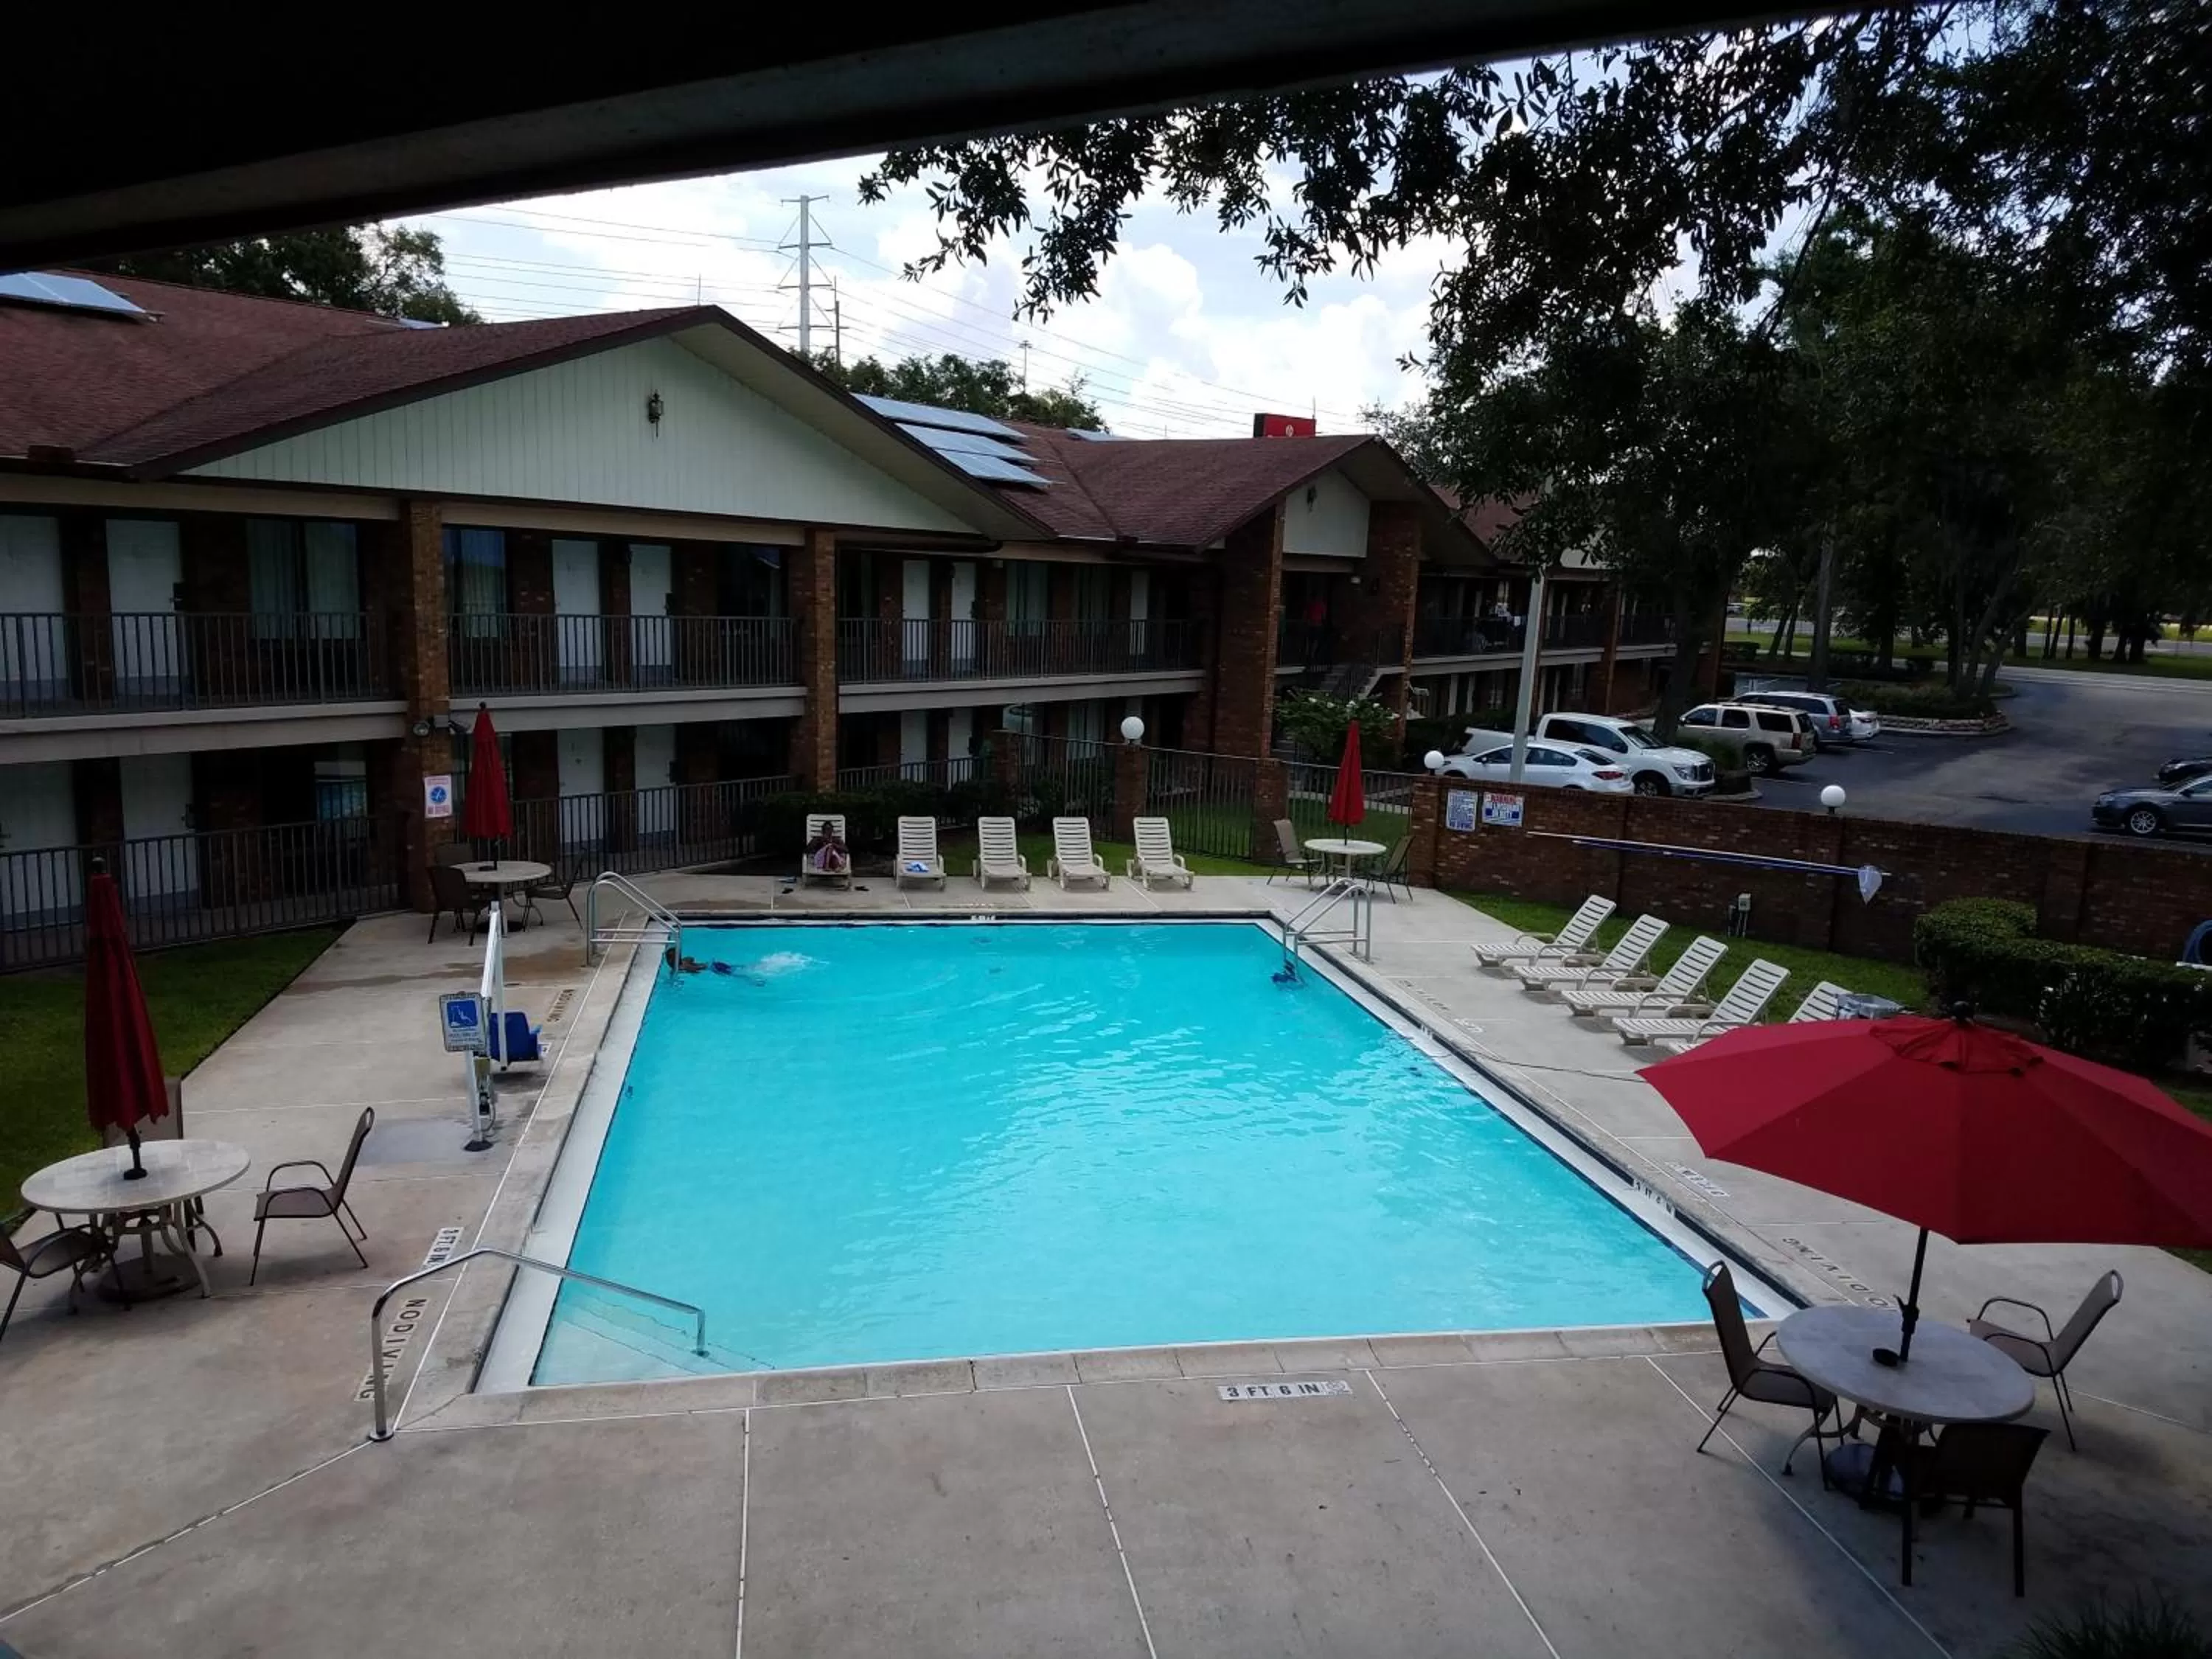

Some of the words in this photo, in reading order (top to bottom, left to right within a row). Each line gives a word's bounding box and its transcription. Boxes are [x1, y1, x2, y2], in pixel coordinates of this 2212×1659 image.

[1227, 1387, 1239, 1397] 3
[1247, 1385, 1270, 1397] FT
[1279, 1385, 1293, 1396] 6
[1298, 1383, 1321, 1394] IN
